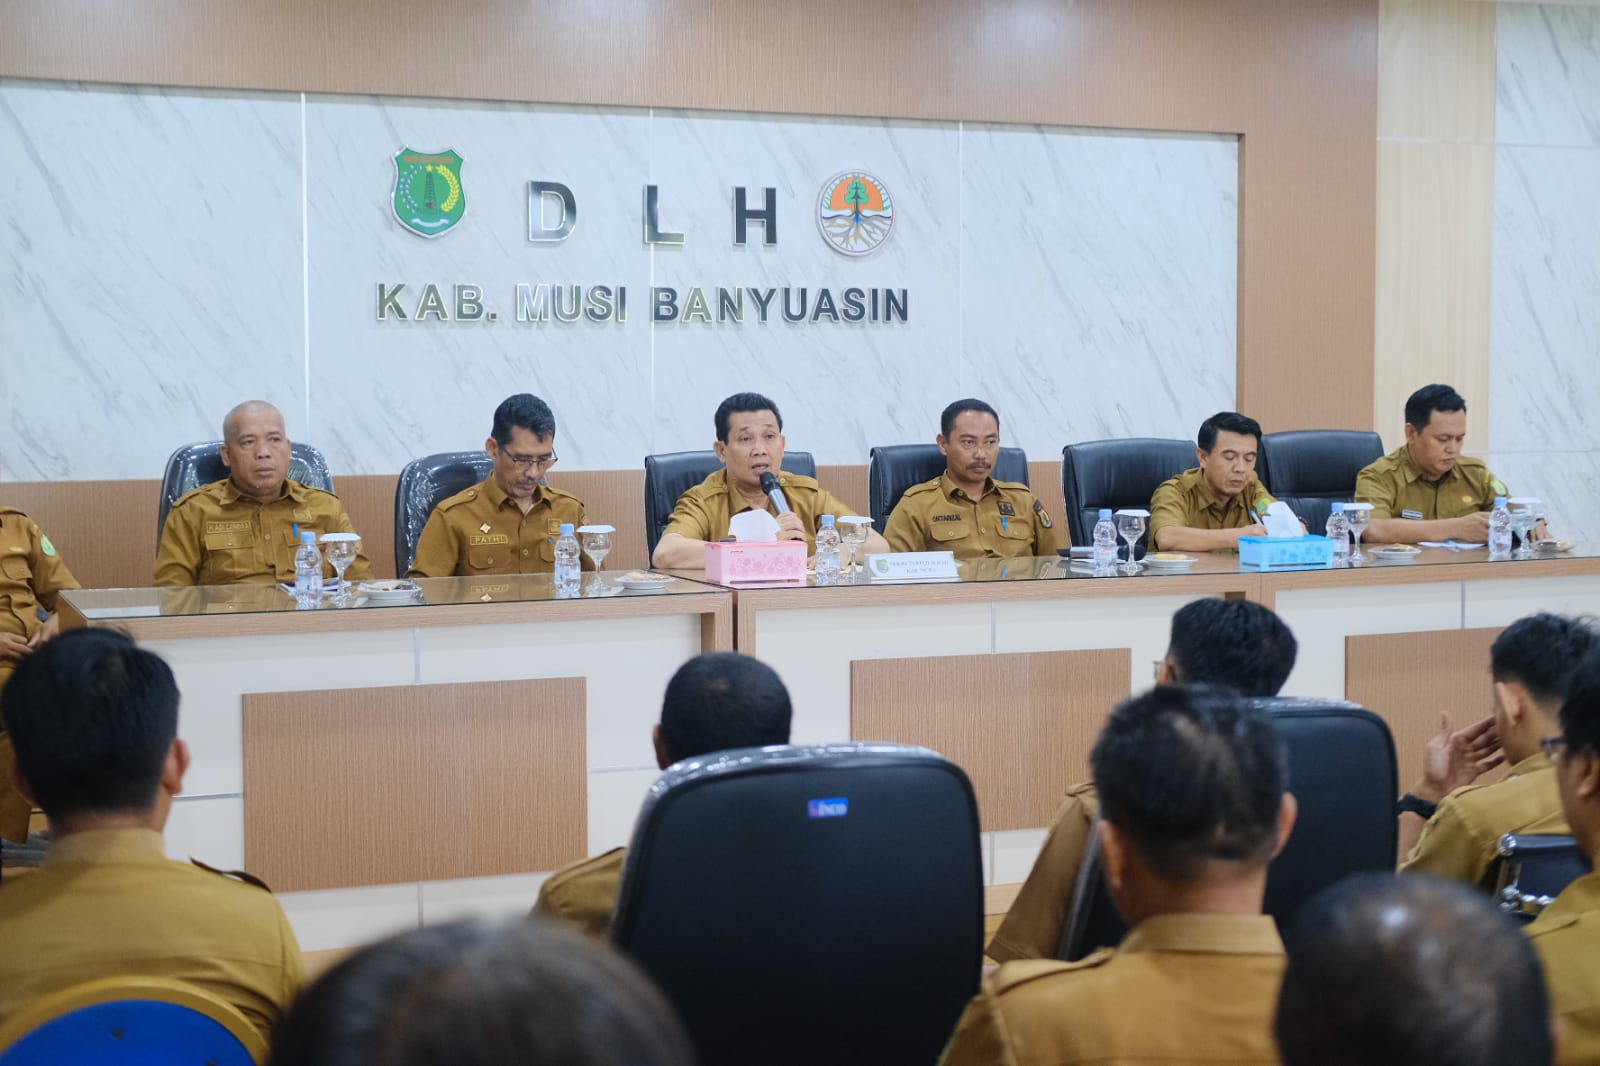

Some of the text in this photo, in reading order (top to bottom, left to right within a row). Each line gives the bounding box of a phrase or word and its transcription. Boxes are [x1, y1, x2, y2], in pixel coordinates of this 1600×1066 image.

[527, 180, 778, 247] D L H
[376, 282, 910, 325] KAB. MUSI BANYUASIN
